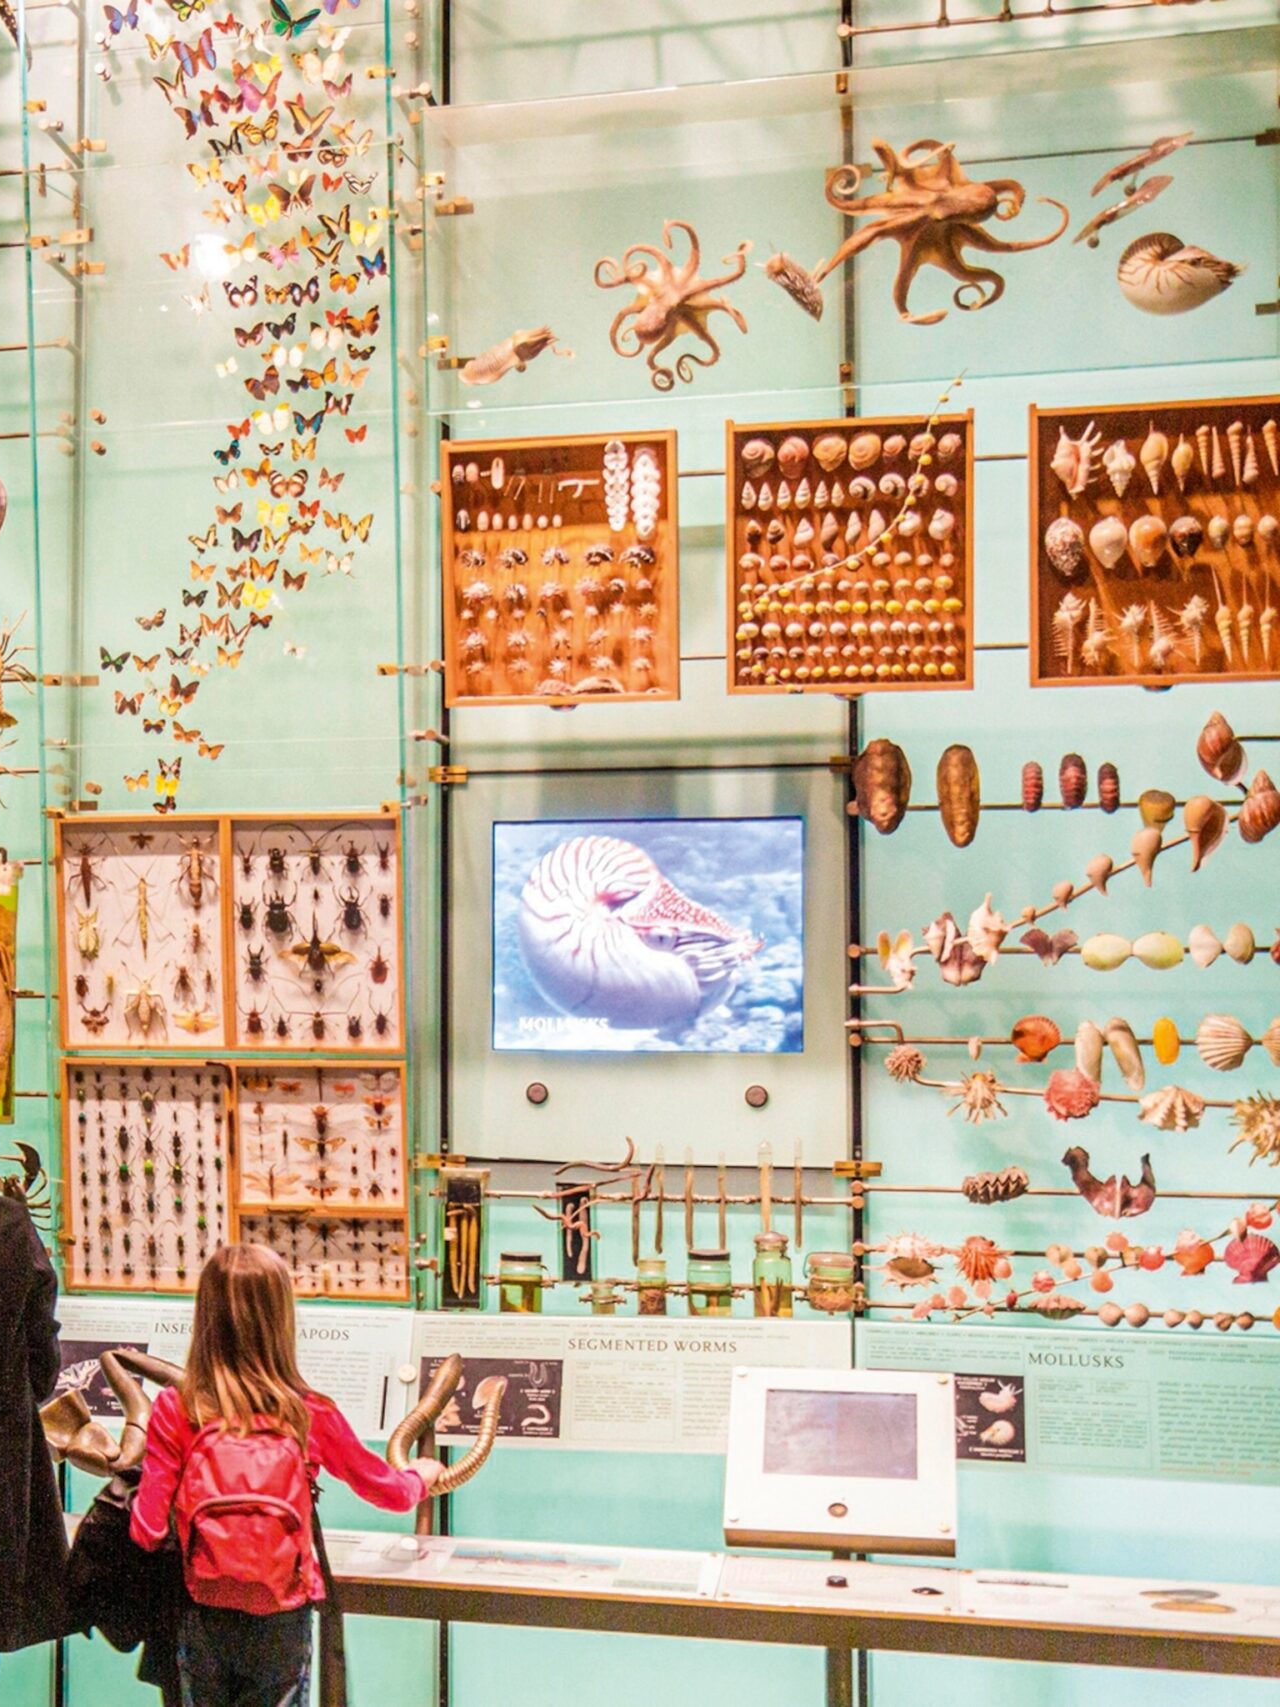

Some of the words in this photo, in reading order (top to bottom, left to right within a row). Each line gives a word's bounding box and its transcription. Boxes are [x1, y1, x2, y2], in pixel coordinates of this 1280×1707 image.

[519, 1016, 609, 1032] MOLLSKS
[568, 1338, 668, 1351] SEGMENTED
[674, 1339, 738, 1353] WORMS
[1028, 1352, 1125, 1369] MOLLUSKS
